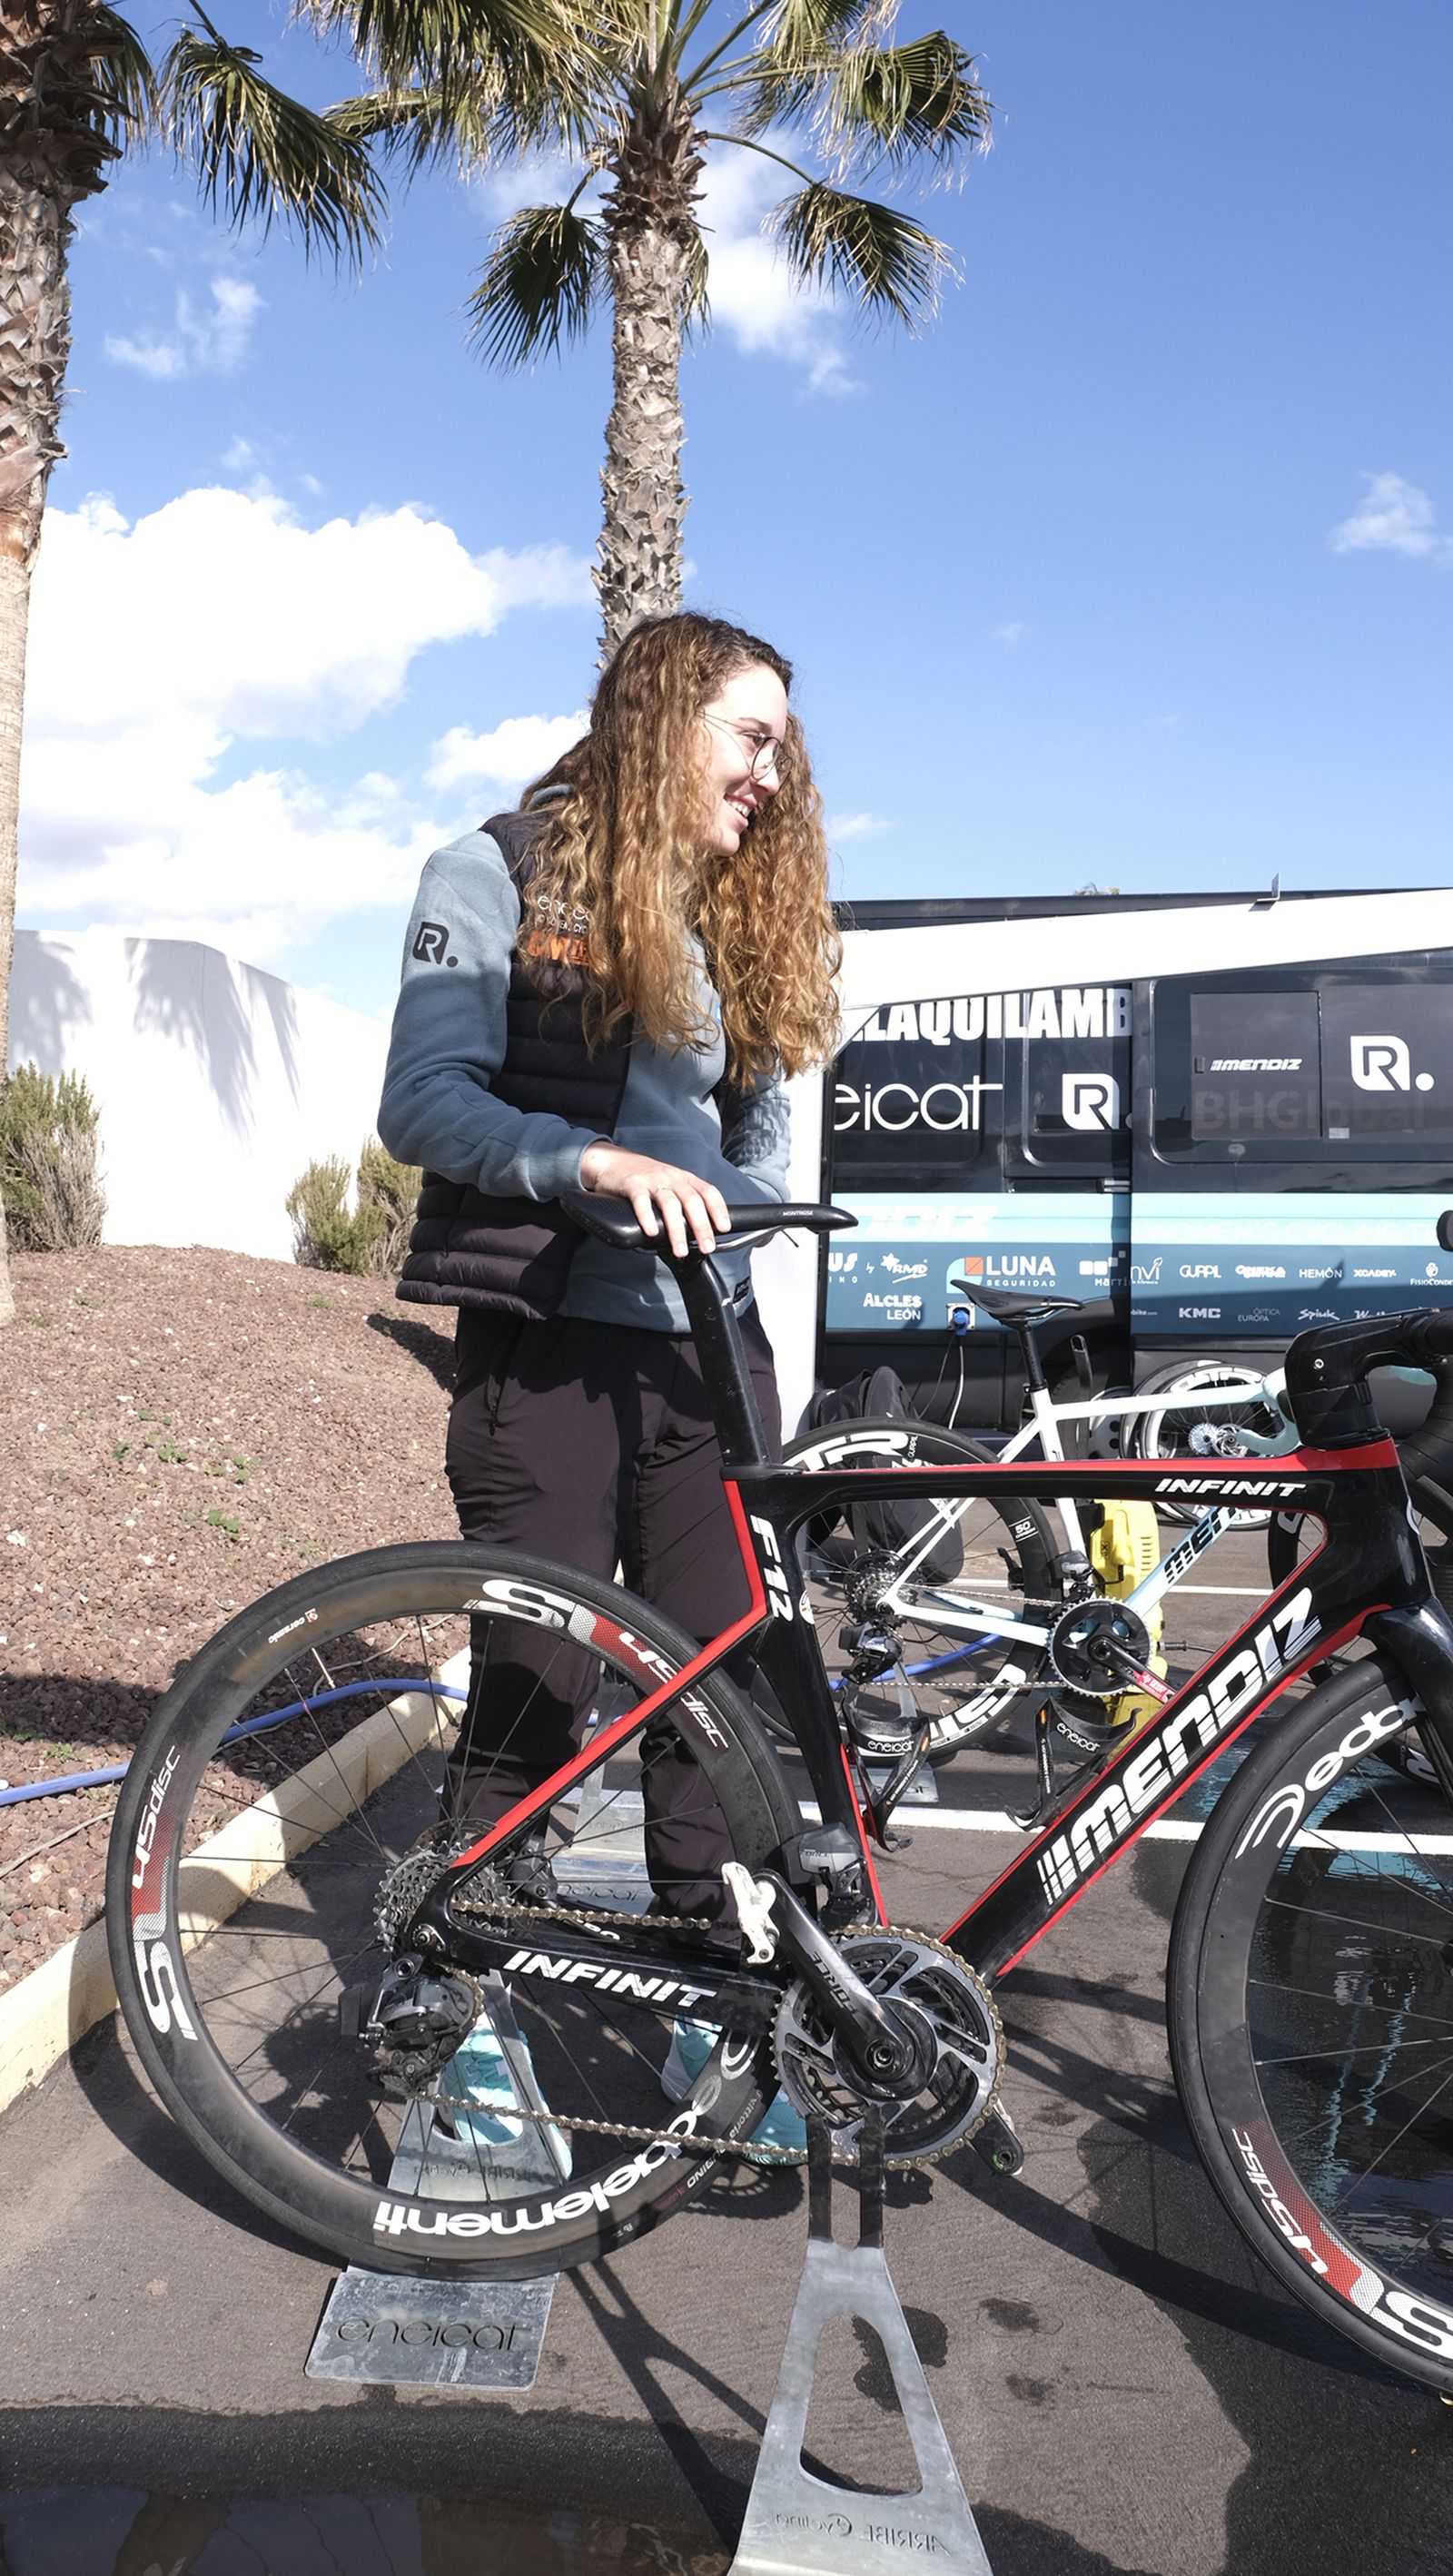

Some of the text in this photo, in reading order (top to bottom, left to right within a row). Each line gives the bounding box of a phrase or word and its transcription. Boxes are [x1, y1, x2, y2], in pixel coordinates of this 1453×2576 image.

[986, 1256, 1056, 1276] LUNA
[1300, 1268, 1342, 1278] HEMÓN
[987, 1278, 1056, 1287] SEGURIDAD
[864, 1292, 923, 1308] ALCLES
[886, 1308, 921, 1320] LEÓN
[1180, 1308, 1221, 1318] KMC
[1155, 1478, 1306, 1497] INFINIT
[1015, 1521, 1031, 1534] 50
[750, 1514, 795, 1623] F12
[503, 1950, 717, 2008] INFINIT
[337, 2316, 531, 2351] eneicat
